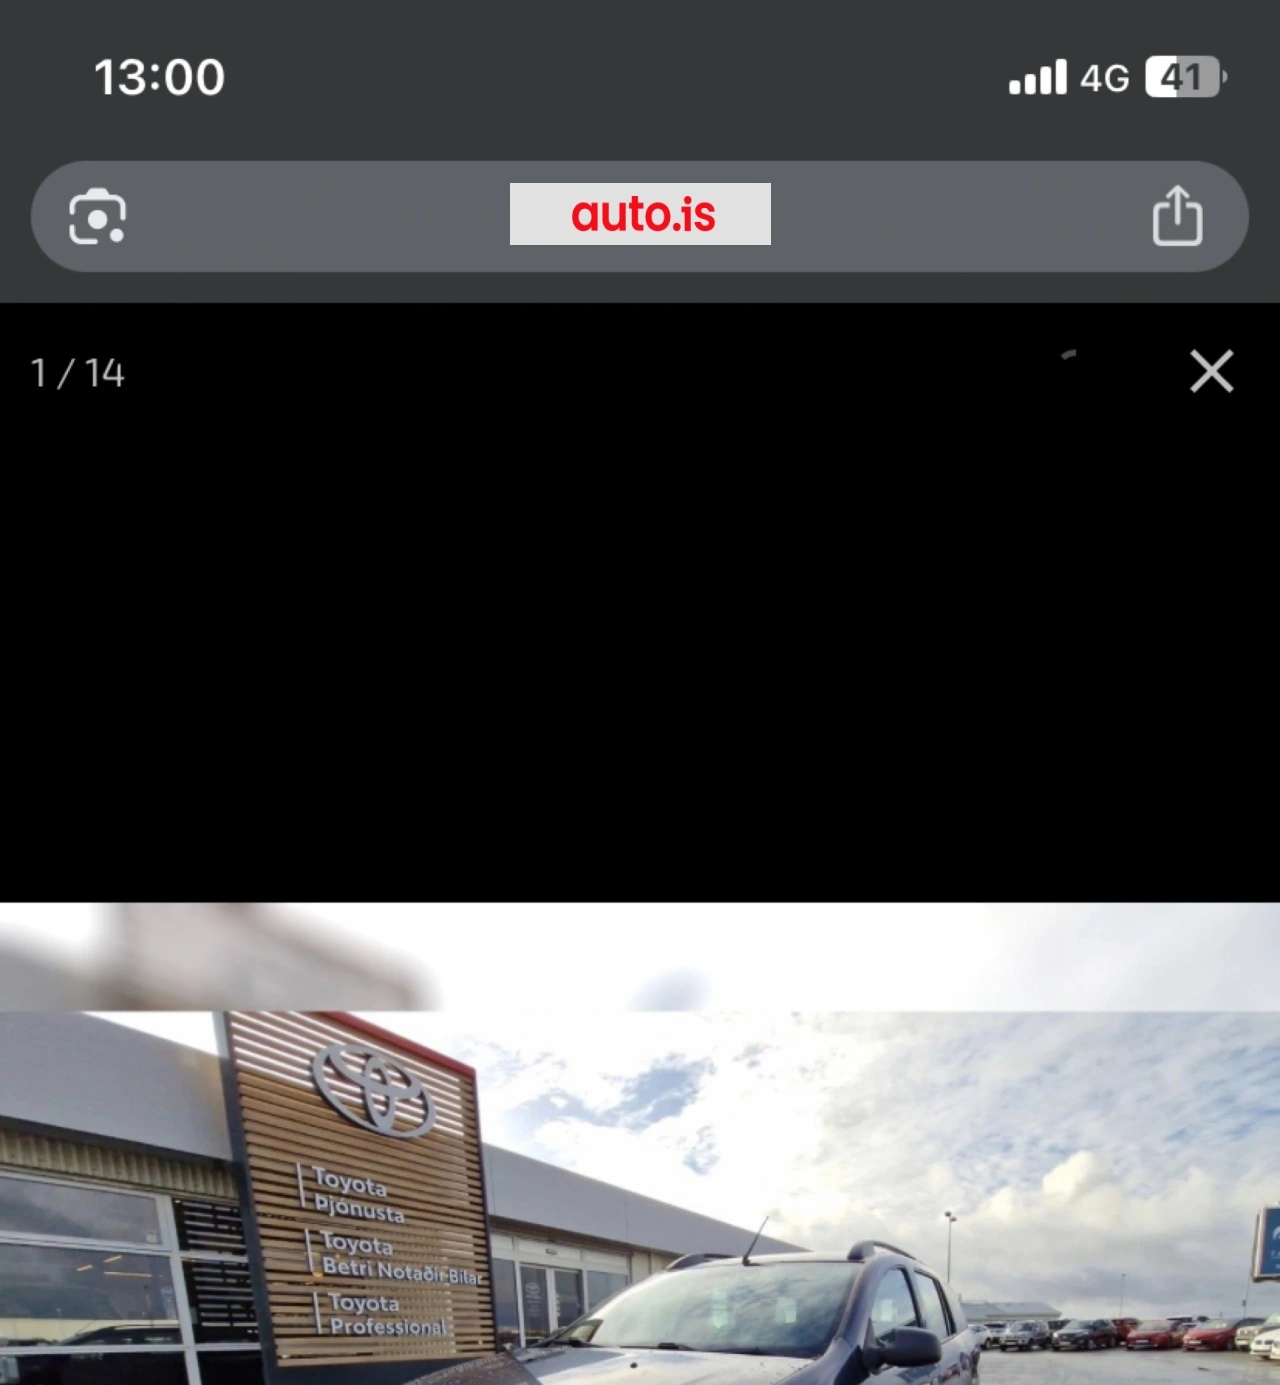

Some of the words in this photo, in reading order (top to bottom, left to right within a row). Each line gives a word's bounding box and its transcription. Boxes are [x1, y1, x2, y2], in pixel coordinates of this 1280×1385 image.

[95, 58, 225, 97] 13:00
[1080, 63, 1130, 93] 4G
[1160, 62, 1200, 91] 41
[31, 357, 44, 388] 1
[85, 357, 125, 388] 14
[312, 1165, 387, 1197] Toyota
[315, 1193, 405, 1224] Þjónusta
[320, 1230, 393, 1255] Toyota
[323, 1256, 373, 1275] Betri
[328, 1292, 400, 1314] Toyota
[330, 1316, 448, 1336] Professional
